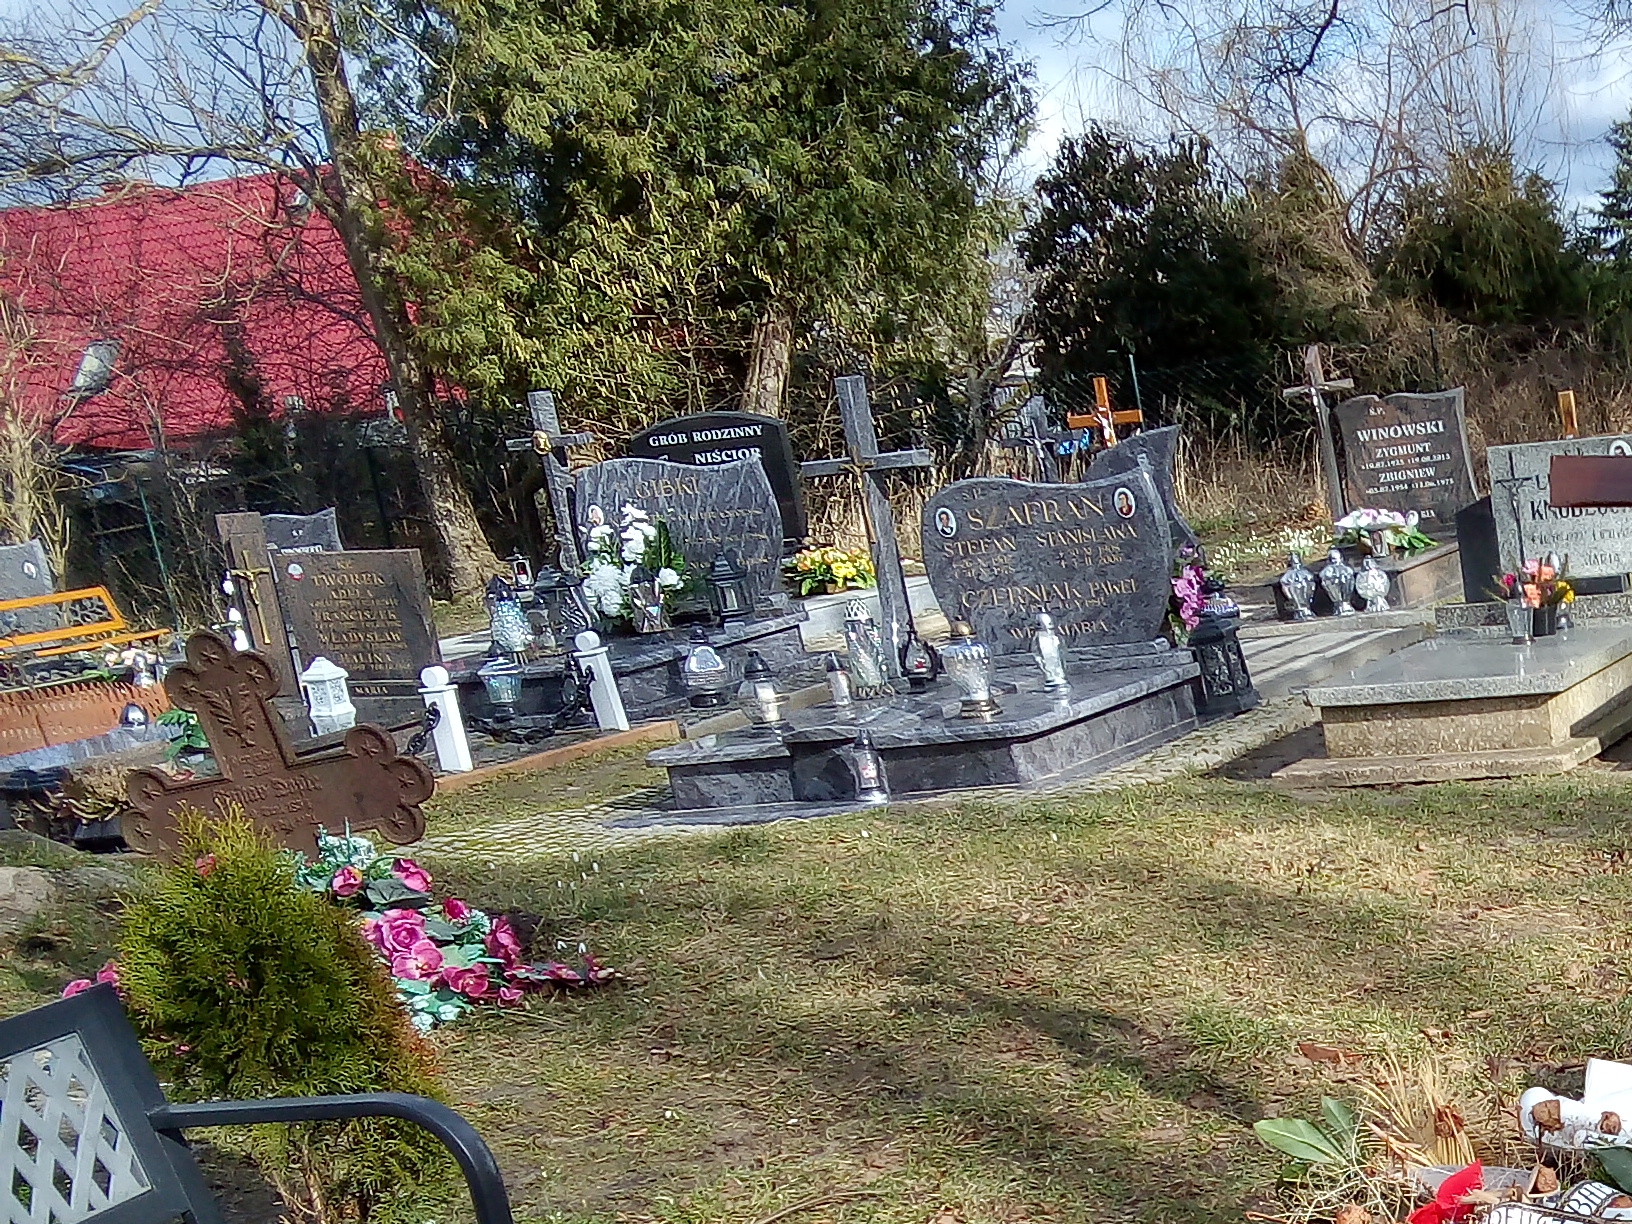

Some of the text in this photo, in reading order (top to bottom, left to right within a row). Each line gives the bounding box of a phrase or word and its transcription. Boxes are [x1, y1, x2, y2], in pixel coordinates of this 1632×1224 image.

[649, 424, 763, 447] GRÓB RODZINNY
[1356, 420, 1445, 442] WINOWSKI
[1375, 442, 1432, 458] ZYGMUNT
[1378, 466, 1437, 483] ZBIGNIEW
[966, 494, 1106, 531] SZAFRAN
[942, 536, 1018, 559] STEFAN
[311, 571, 385, 587] TWOREK
[962, 581, 1082, 609] CZERNIAK
